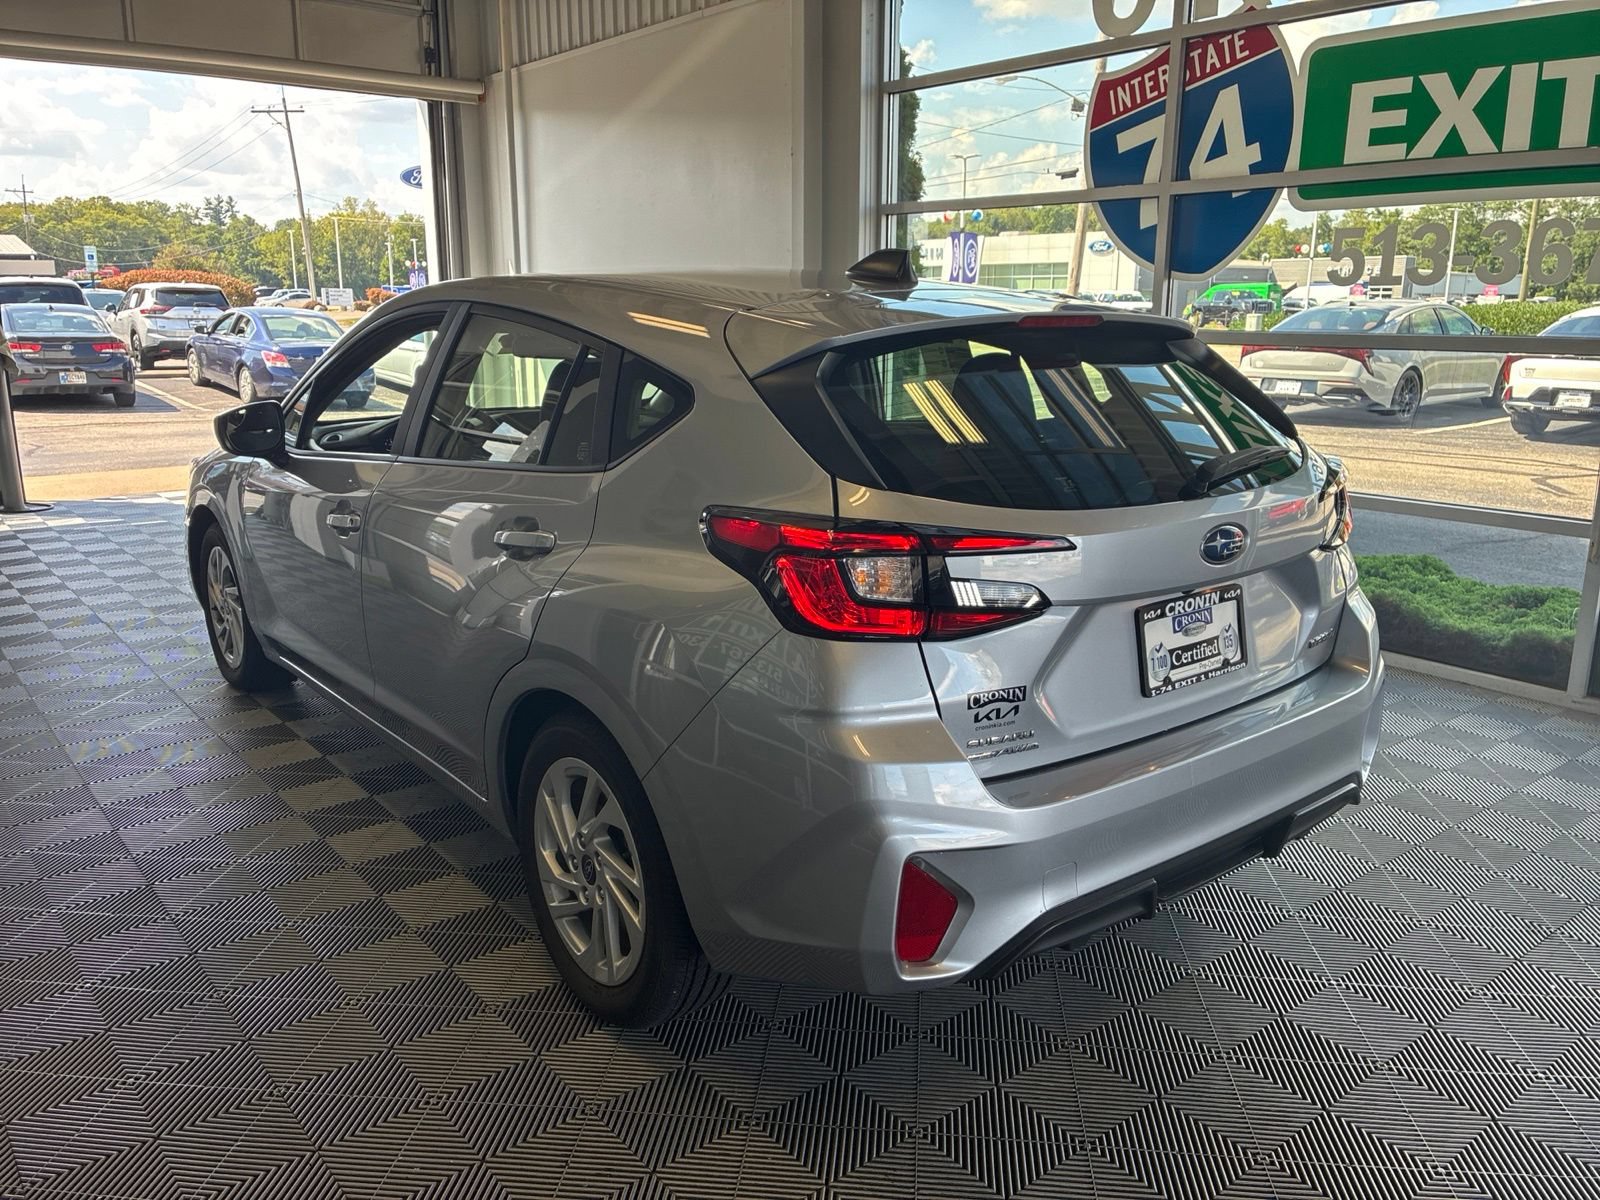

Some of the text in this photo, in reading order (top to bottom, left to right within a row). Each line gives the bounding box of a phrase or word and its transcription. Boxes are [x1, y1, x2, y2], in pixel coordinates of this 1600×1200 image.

[1110, 30, 1250, 116] INTERTATE
[1343, 55, 1600, 165] EXIT
[1116, 83, 1262, 229] 74
[1165, 591, 1220, 617] CRONIN
[1174, 609, 1211, 631] CRONIN
[1172, 639, 1219, 666] Certified
[1151, 685, 1173, 697] I-74
[1175, 676, 1198, 689] EXIT
[1208, 662, 1246, 679] Harrison
[969, 687, 1025, 708] CRONIN
[974, 704, 1020, 723] KIA
[974, 720, 1016, 732] croninkia.com
